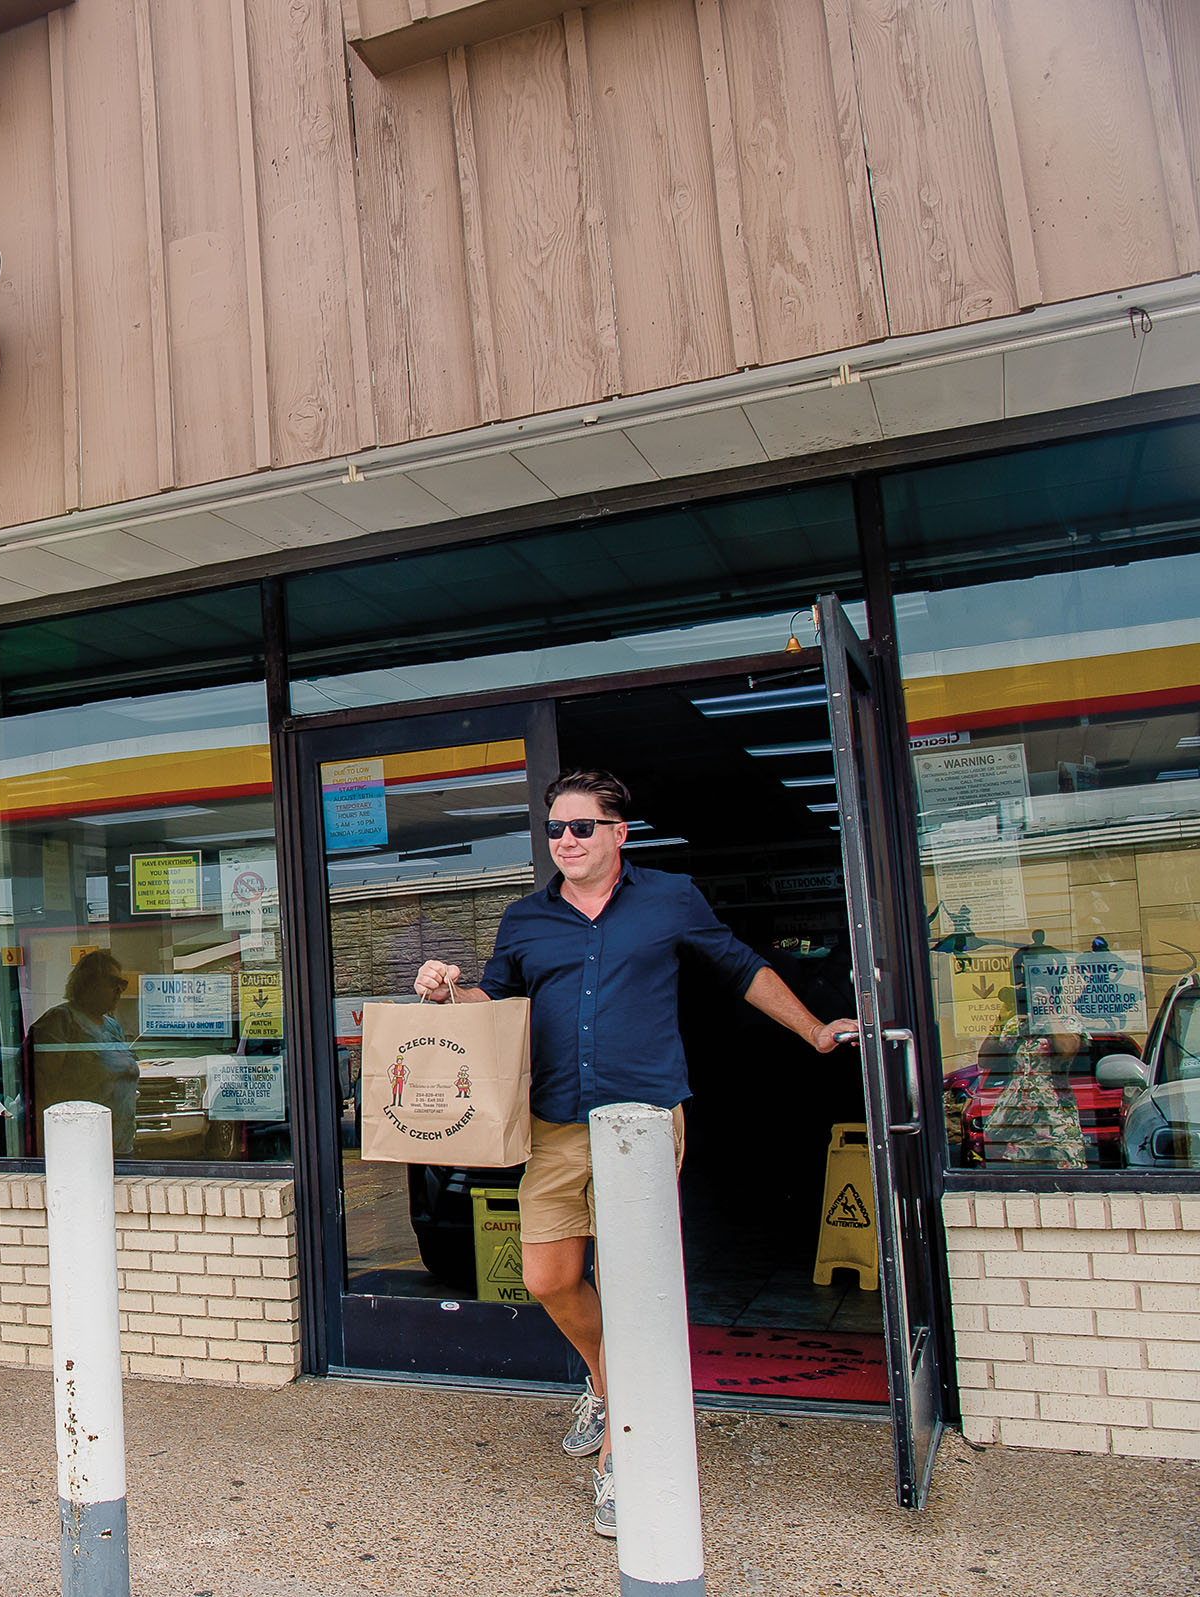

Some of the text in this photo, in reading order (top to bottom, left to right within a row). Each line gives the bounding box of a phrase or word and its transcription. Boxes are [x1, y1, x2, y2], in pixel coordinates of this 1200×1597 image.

[944, 755, 995, 769] WARNING
[774, 875, 832, 889] RESTROOMS
[955, 958, 1009, 971] CAUTION
[241, 974, 279, 985] CAUTION
[1068, 975, 1076, 984] IS
[1077, 975, 1083, 984] A
[1083, 974, 1110, 984] CRIME
[161, 980, 207, 994] UNDER 21
[1051, 984, 1119, 995] (MISDEMEANOR)
[1037, 993, 1136, 1005] TO CONSUME LIQUOR OR
[968, 1003, 1001, 1011] PLEASE
[1033, 1006, 1055, 1016] BEER
[1056, 1005, 1068, 1015] ON
[1071, 1004, 1096, 1014] THESE
[971, 1014, 1001, 1022] WATCH
[155, 1020, 186, 1029] PREPARED
[187, 1021, 196, 1029] TO
[196, 1020, 215, 1029] SHOW
[398, 1037, 466, 1055] CZECH STOP
[221, 1090, 247, 1098] CERVEZA
[256, 1090, 270, 1098] ESTE
[383, 1105, 476, 1140] LITTLE CZECH BAKERY
[828, 1190, 845, 1215] CAUTION
[484, 1221, 521, 1232] CAUTI
[832, 1220, 864, 1228] ATTENTION
[726, 1329, 864, 1356] STOP
[735, 1351, 883, 1366] BUSINESS
[715, 1363, 861, 1387] BAKERY
